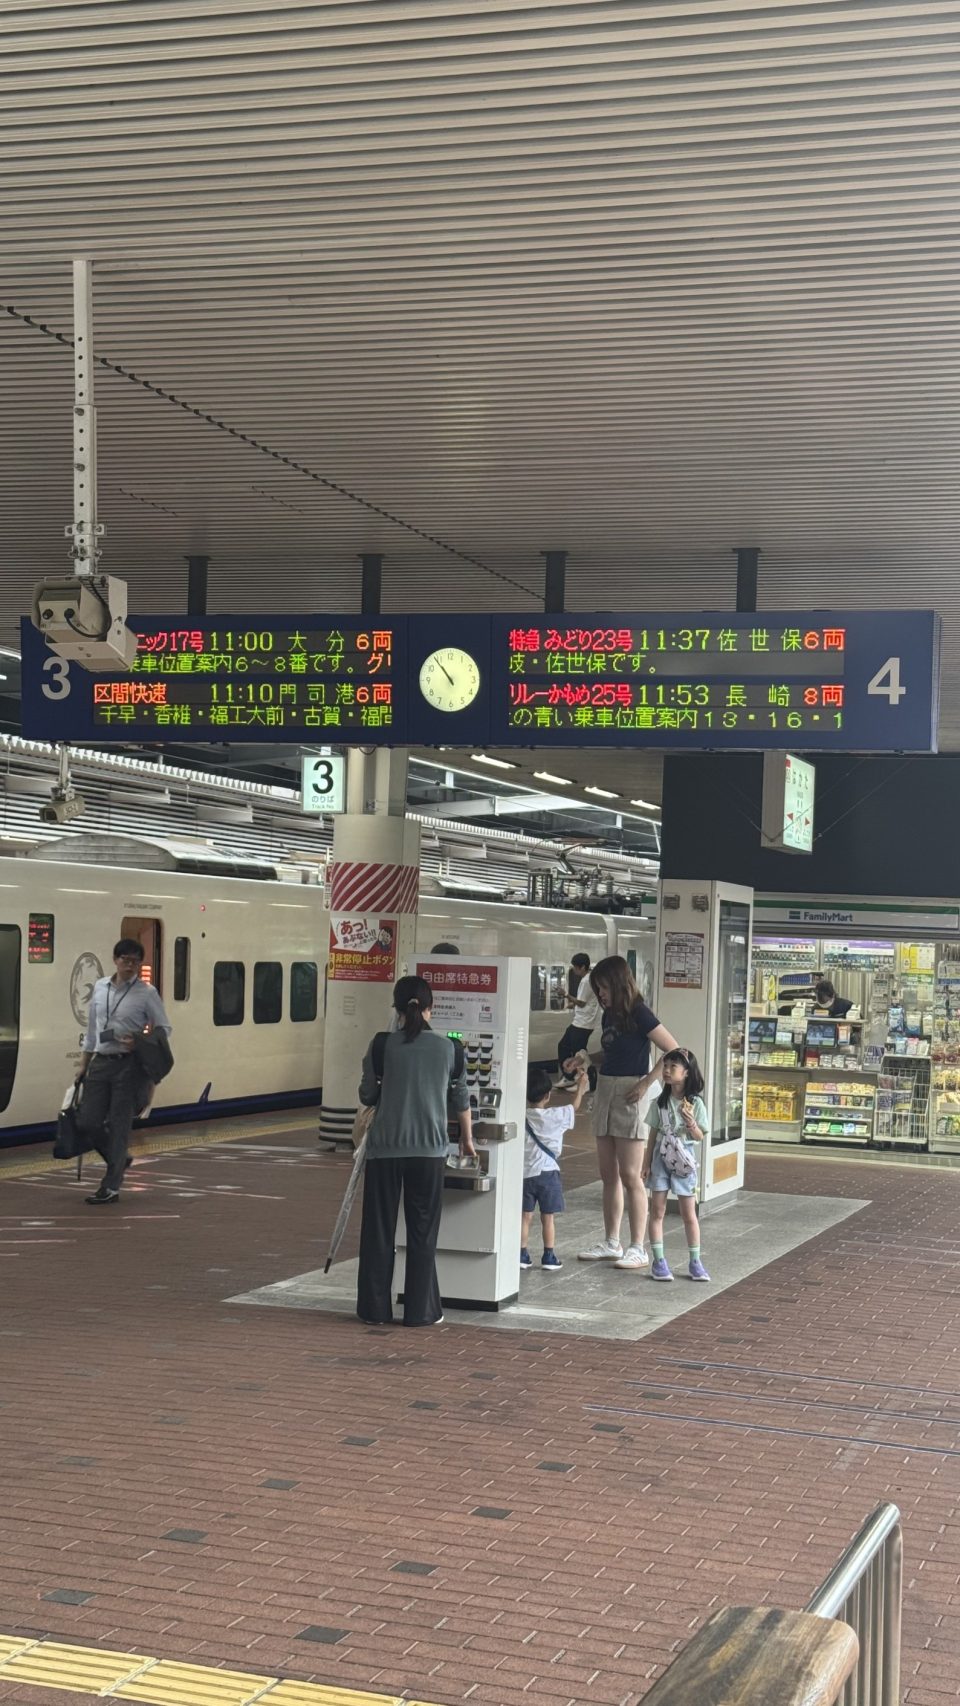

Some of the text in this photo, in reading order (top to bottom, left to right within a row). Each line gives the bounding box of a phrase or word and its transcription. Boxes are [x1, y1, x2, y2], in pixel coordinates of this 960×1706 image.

[210, 631, 273, 651] 11:00
[356, 630, 392, 651] 6両
[544, 629, 633, 652] みどり23号
[639, 629, 710, 650] 11:37
[803, 628, 846, 651] 6両
[42, 656, 71, 700] 3
[867, 657, 906, 705] 4
[94, 682, 167, 704] 区間快速
[210, 683, 273, 703] 11:10
[356, 683, 392, 704] 6両
[509, 683, 633, 706] リレーかもめ25号
[639, 684, 709, 705] 11:53
[803, 684, 845, 707] 8両
[312, 759, 334, 794] 3
[803, 911, 854, 922] FamilyMart
[335, 953, 395, 966] 非常停止ボタン
[422, 971, 491, 986] 自由席特急券
